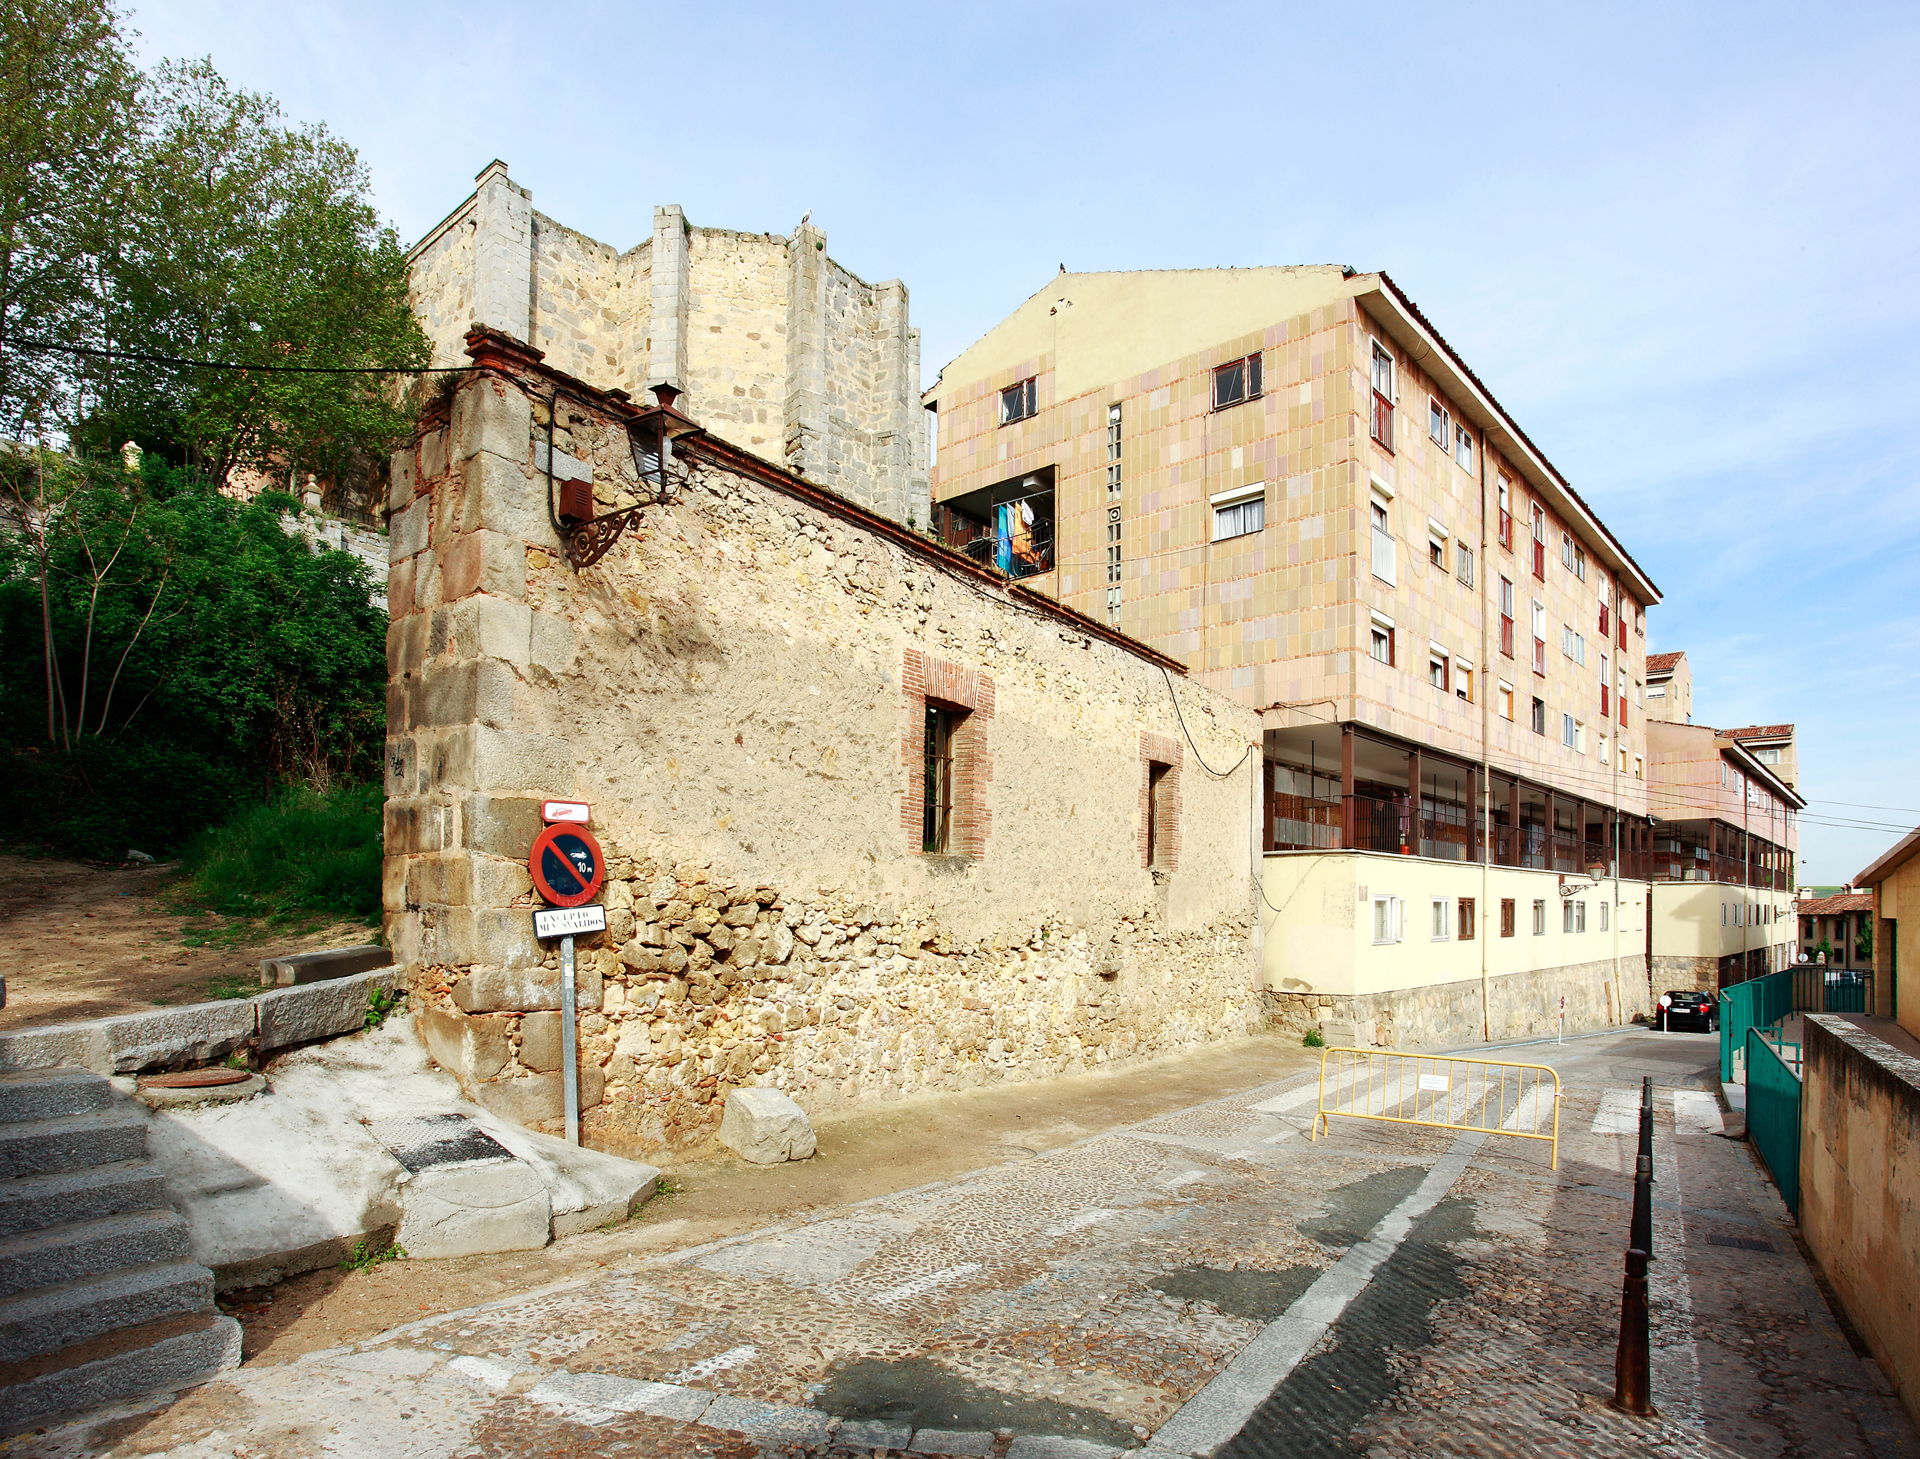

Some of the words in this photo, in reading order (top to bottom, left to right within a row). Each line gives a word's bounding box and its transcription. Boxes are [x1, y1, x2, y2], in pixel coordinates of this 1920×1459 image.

[577, 861, 586, 873] 10
[543, 911, 589, 923] EXCEPTO
[539, 918, 604, 932] MINSVALIDOS
